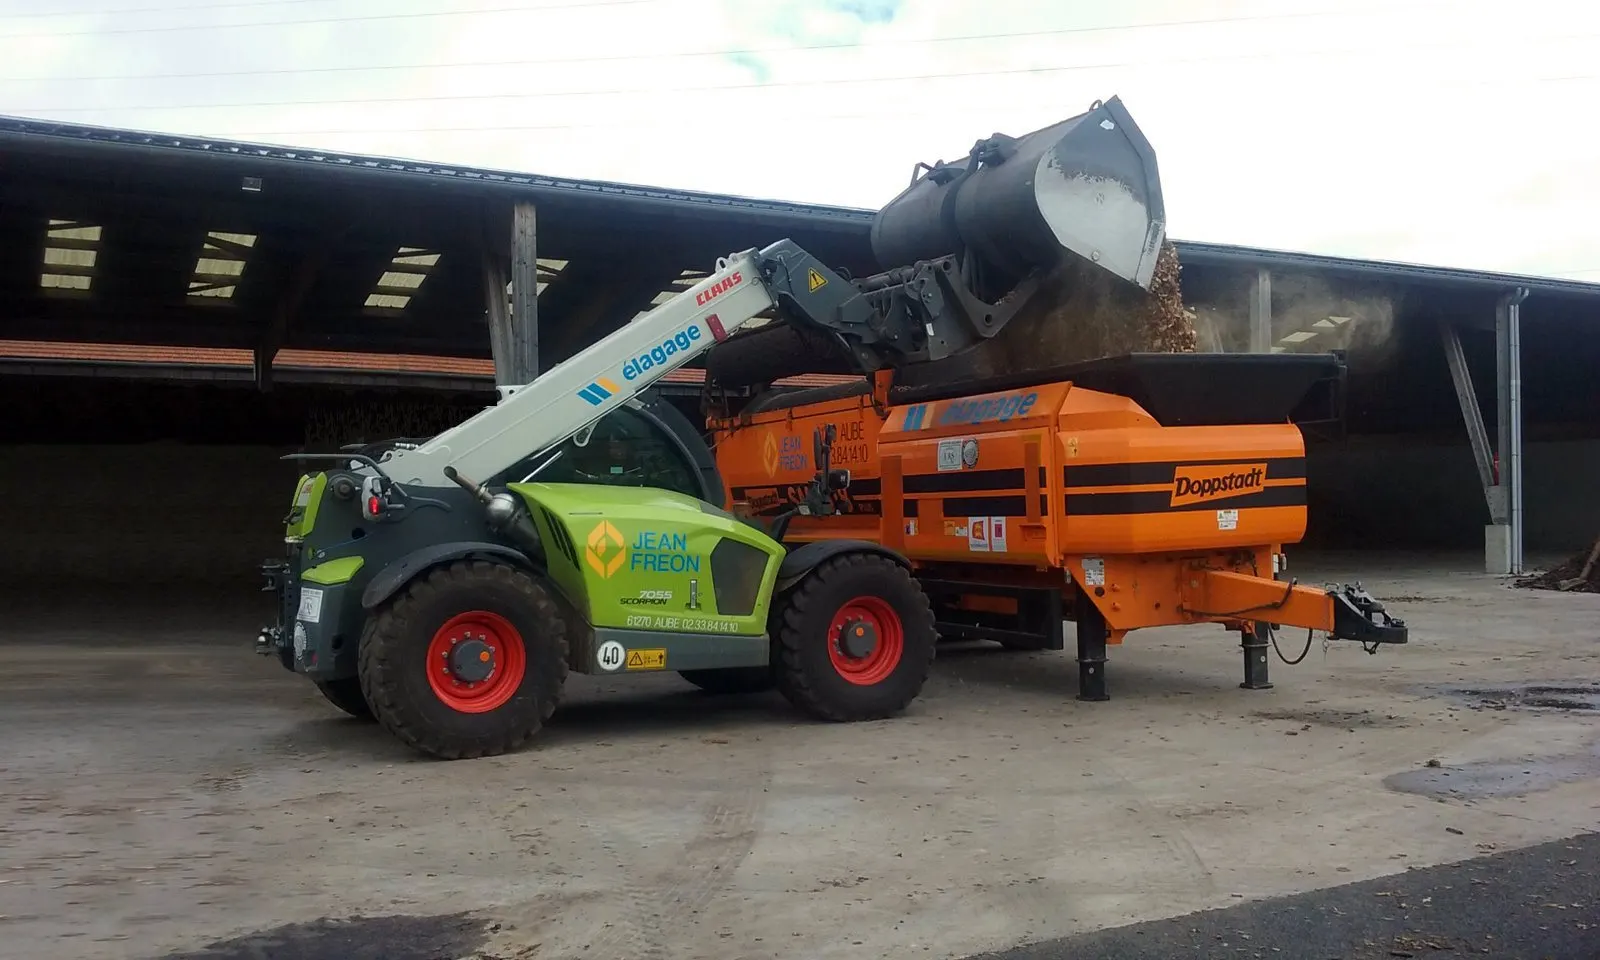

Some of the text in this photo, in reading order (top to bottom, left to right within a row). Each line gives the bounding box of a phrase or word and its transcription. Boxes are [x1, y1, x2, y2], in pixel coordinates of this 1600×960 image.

[696, 271, 743, 307] CLAAS
[622, 324, 701, 381] élagage
[841, 420, 865, 442] AUBE
[1175, 467, 1263, 497] Doppstadt
[632, 531, 687, 551] JEAN
[630, 552, 700, 573] FREON
[619, 597, 668, 606] SCORPION
[640, 590, 672, 600] 7055
[627, 615, 652, 628] 61270
[654, 616, 680, 629] AUBE
[602, 646, 620, 666] 40
